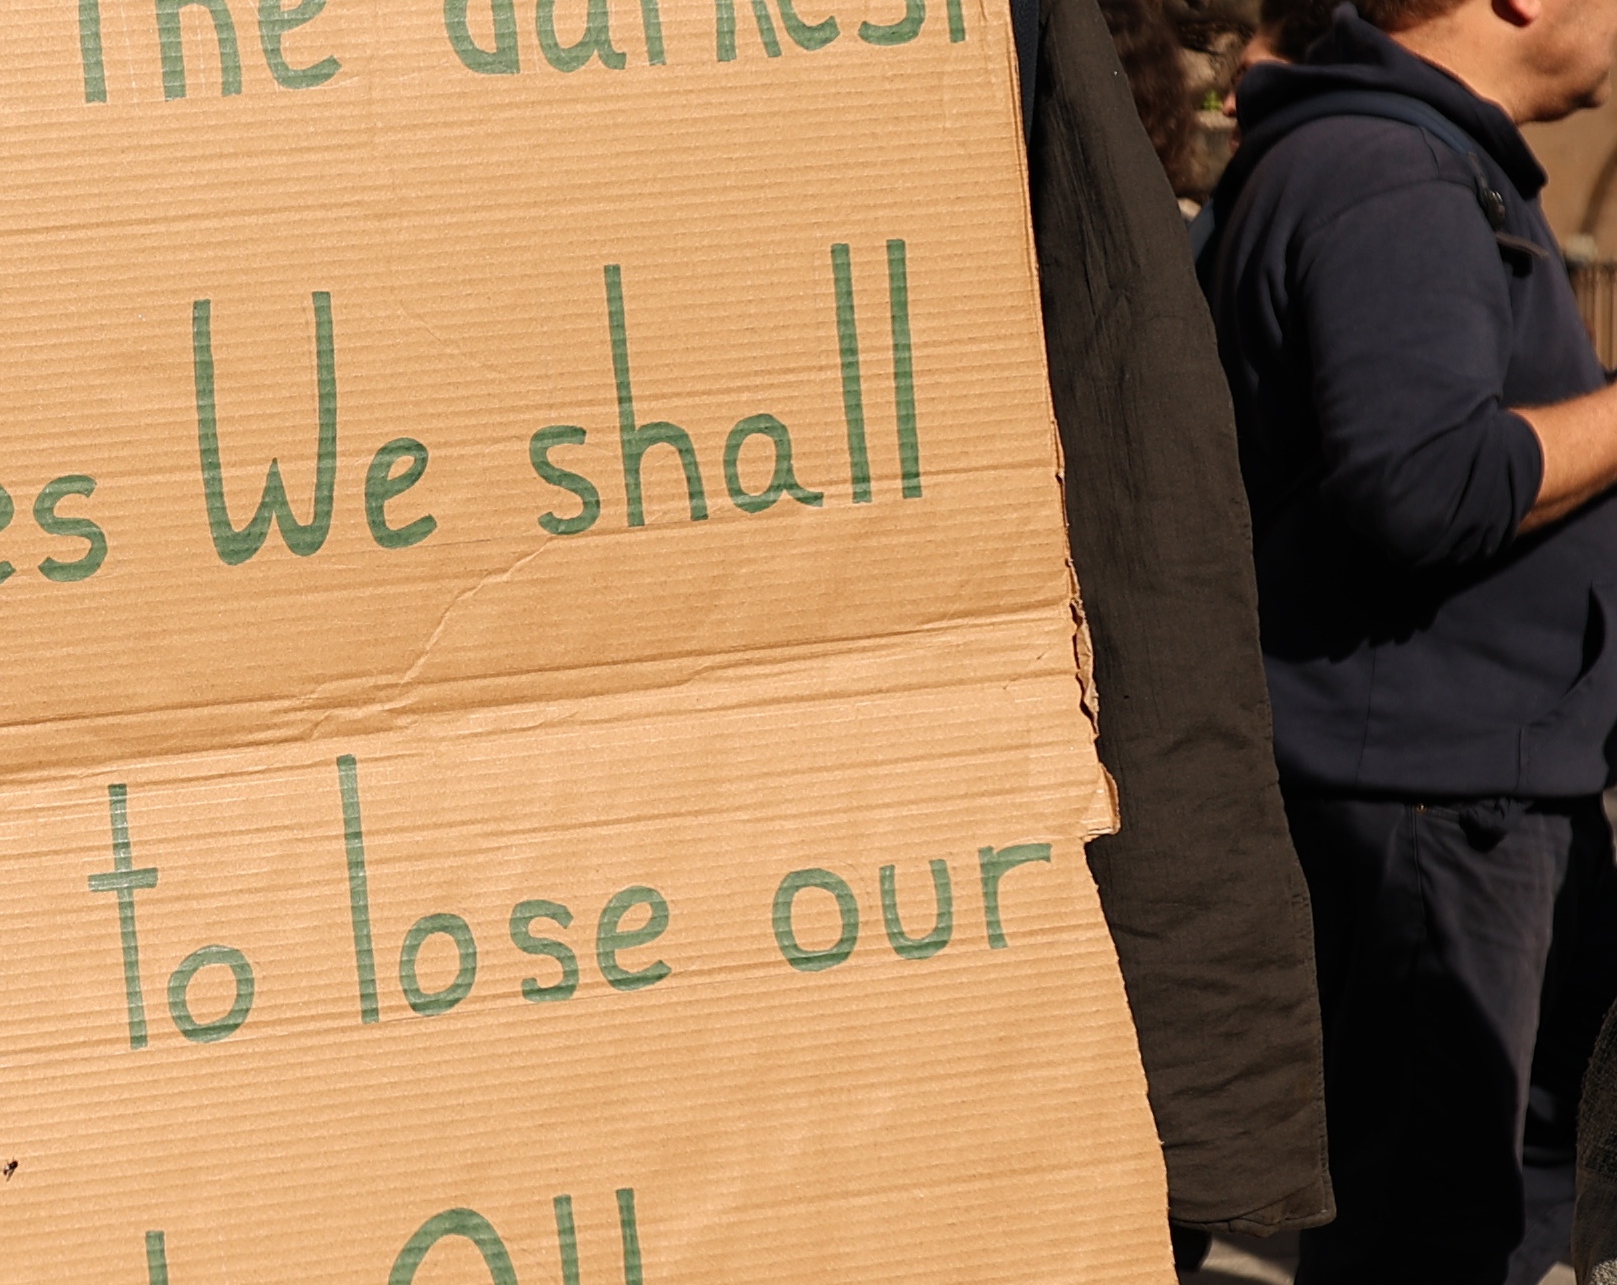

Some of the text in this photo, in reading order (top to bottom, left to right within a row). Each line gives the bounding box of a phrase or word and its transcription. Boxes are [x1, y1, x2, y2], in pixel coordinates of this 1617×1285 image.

[195, 292, 435, 565] We
[532, 240, 921, 534] shall
[92, 785, 253, 1048] to
[339, 756, 669, 1022] lose
[775, 844, 1049, 970] our
